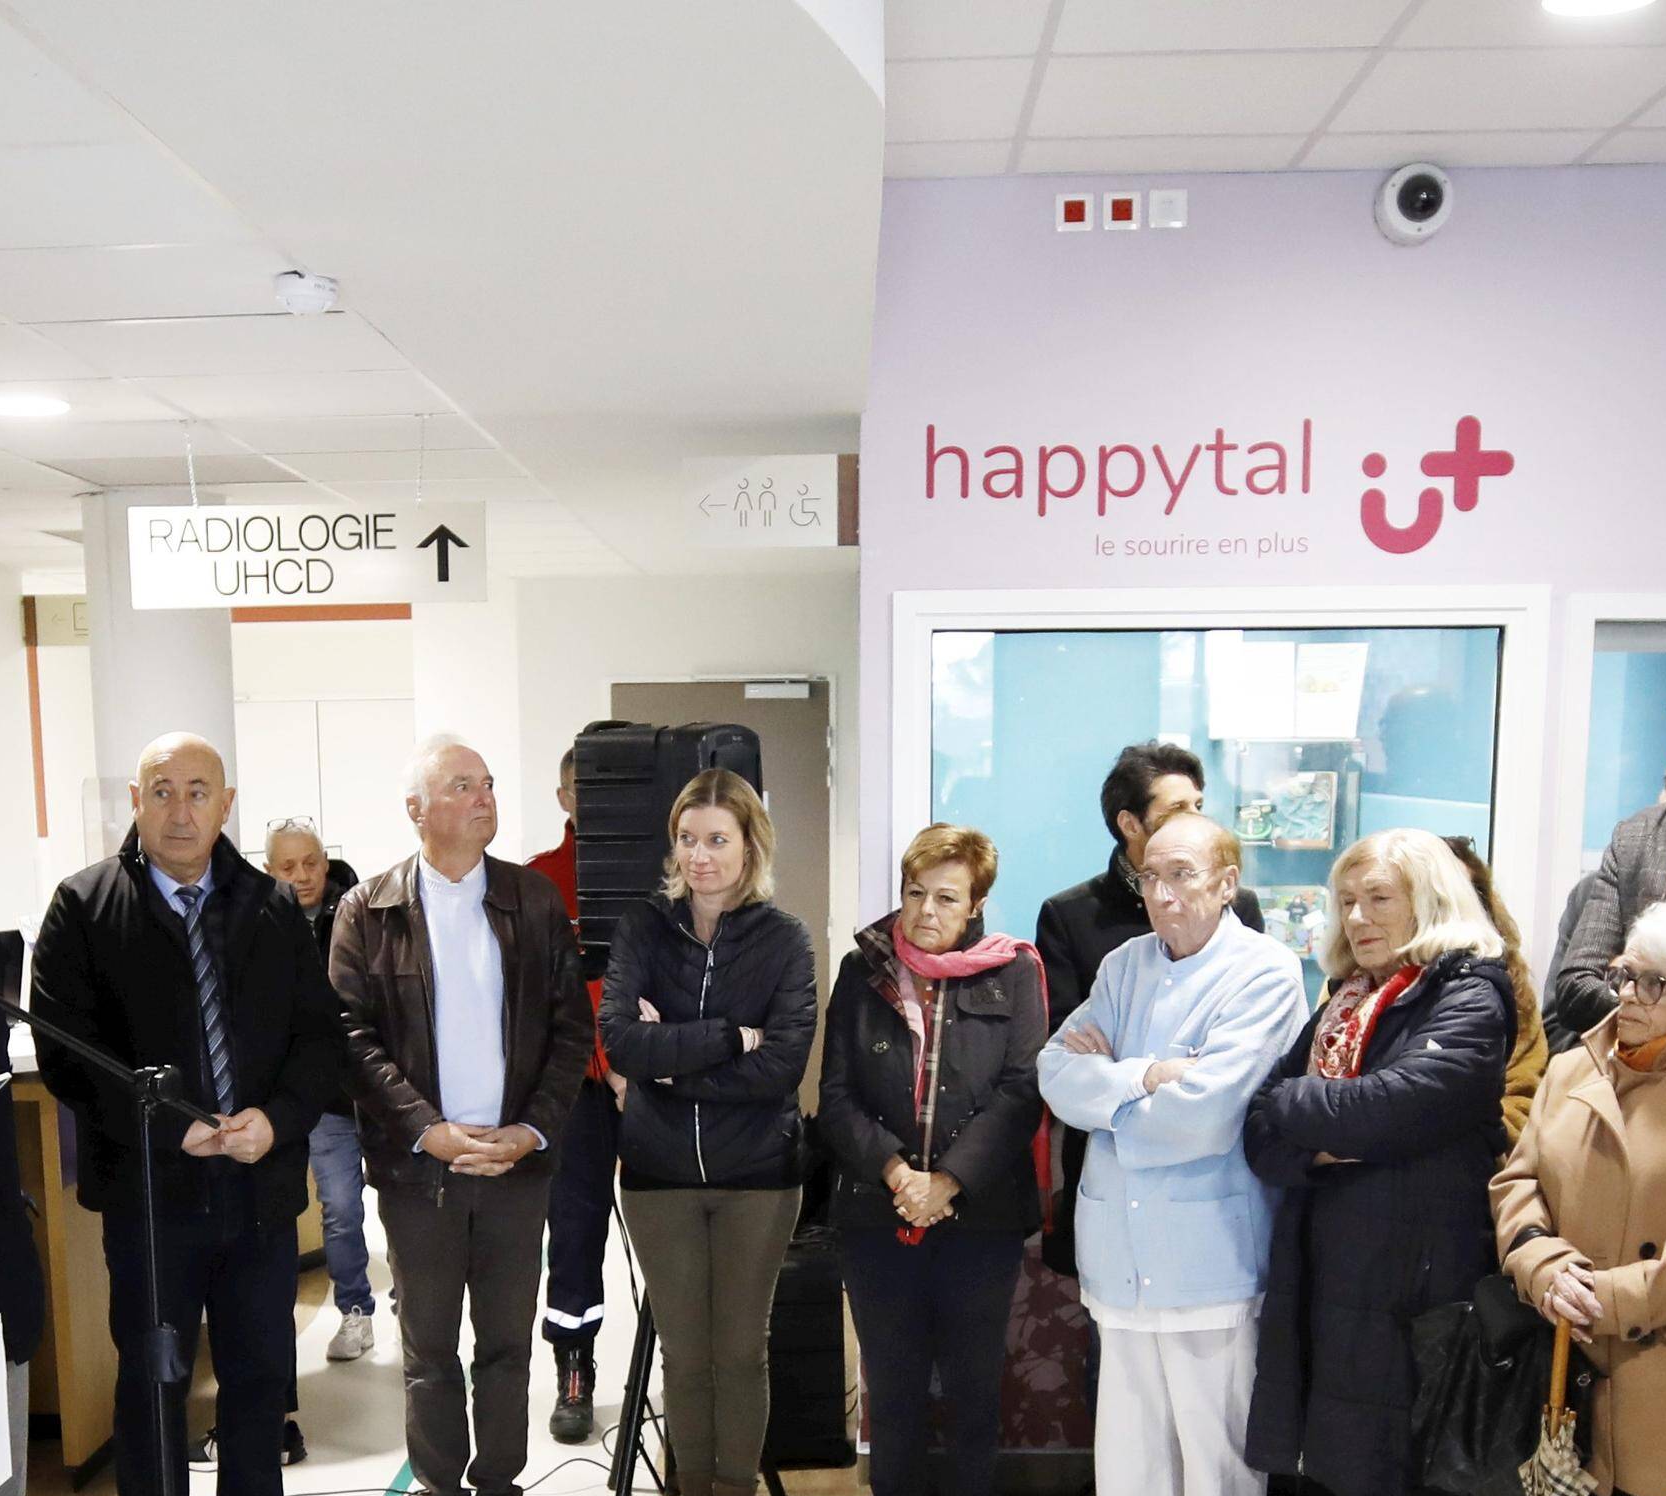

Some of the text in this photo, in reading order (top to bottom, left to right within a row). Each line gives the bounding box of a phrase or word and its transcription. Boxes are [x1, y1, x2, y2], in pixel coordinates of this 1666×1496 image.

[926, 418, 1312, 517] happytal
[149, 513, 397, 553] RADIOLOGIE
[1095, 531, 1309, 559] le sourire en plus
[213, 558, 334, 596] UHCD
